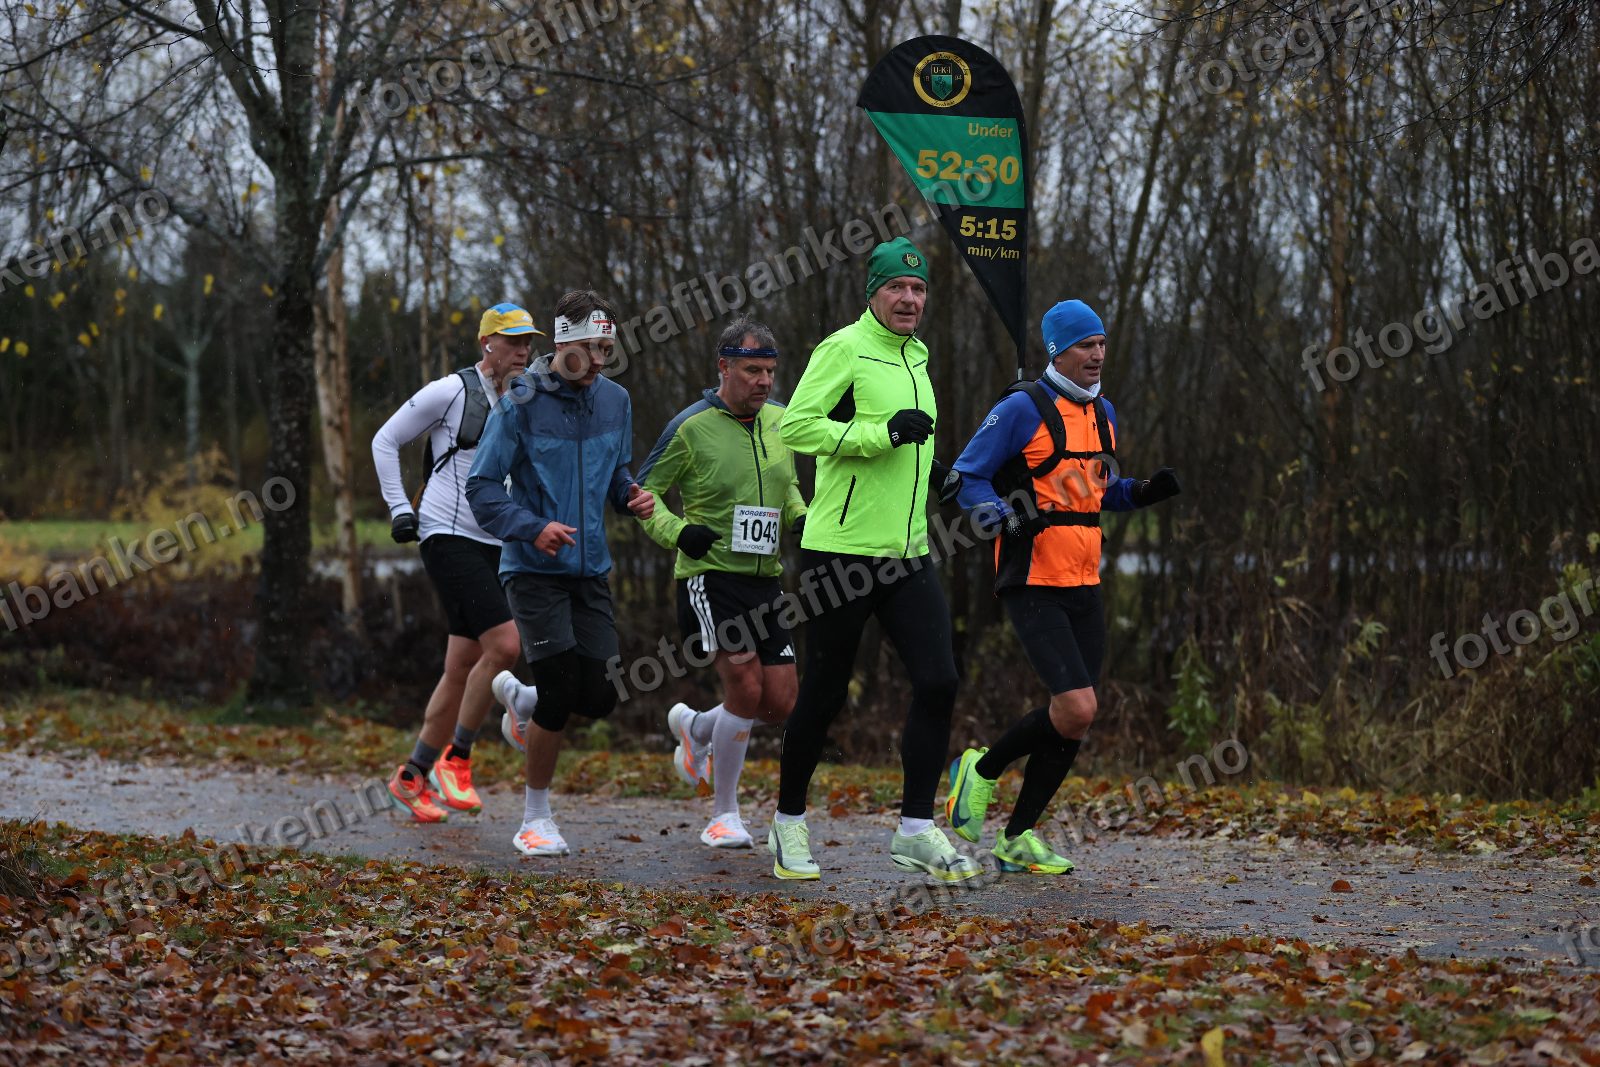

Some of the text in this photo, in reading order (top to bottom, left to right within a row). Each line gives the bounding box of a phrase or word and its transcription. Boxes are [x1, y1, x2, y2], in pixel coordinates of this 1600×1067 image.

[968, 122, 1013, 138] Under
[916, 149, 1020, 185] 52:30
[959, 215, 1017, 241] 5:15
[967, 244, 1020, 260] min/km
[740, 518, 778, 544] 1043
